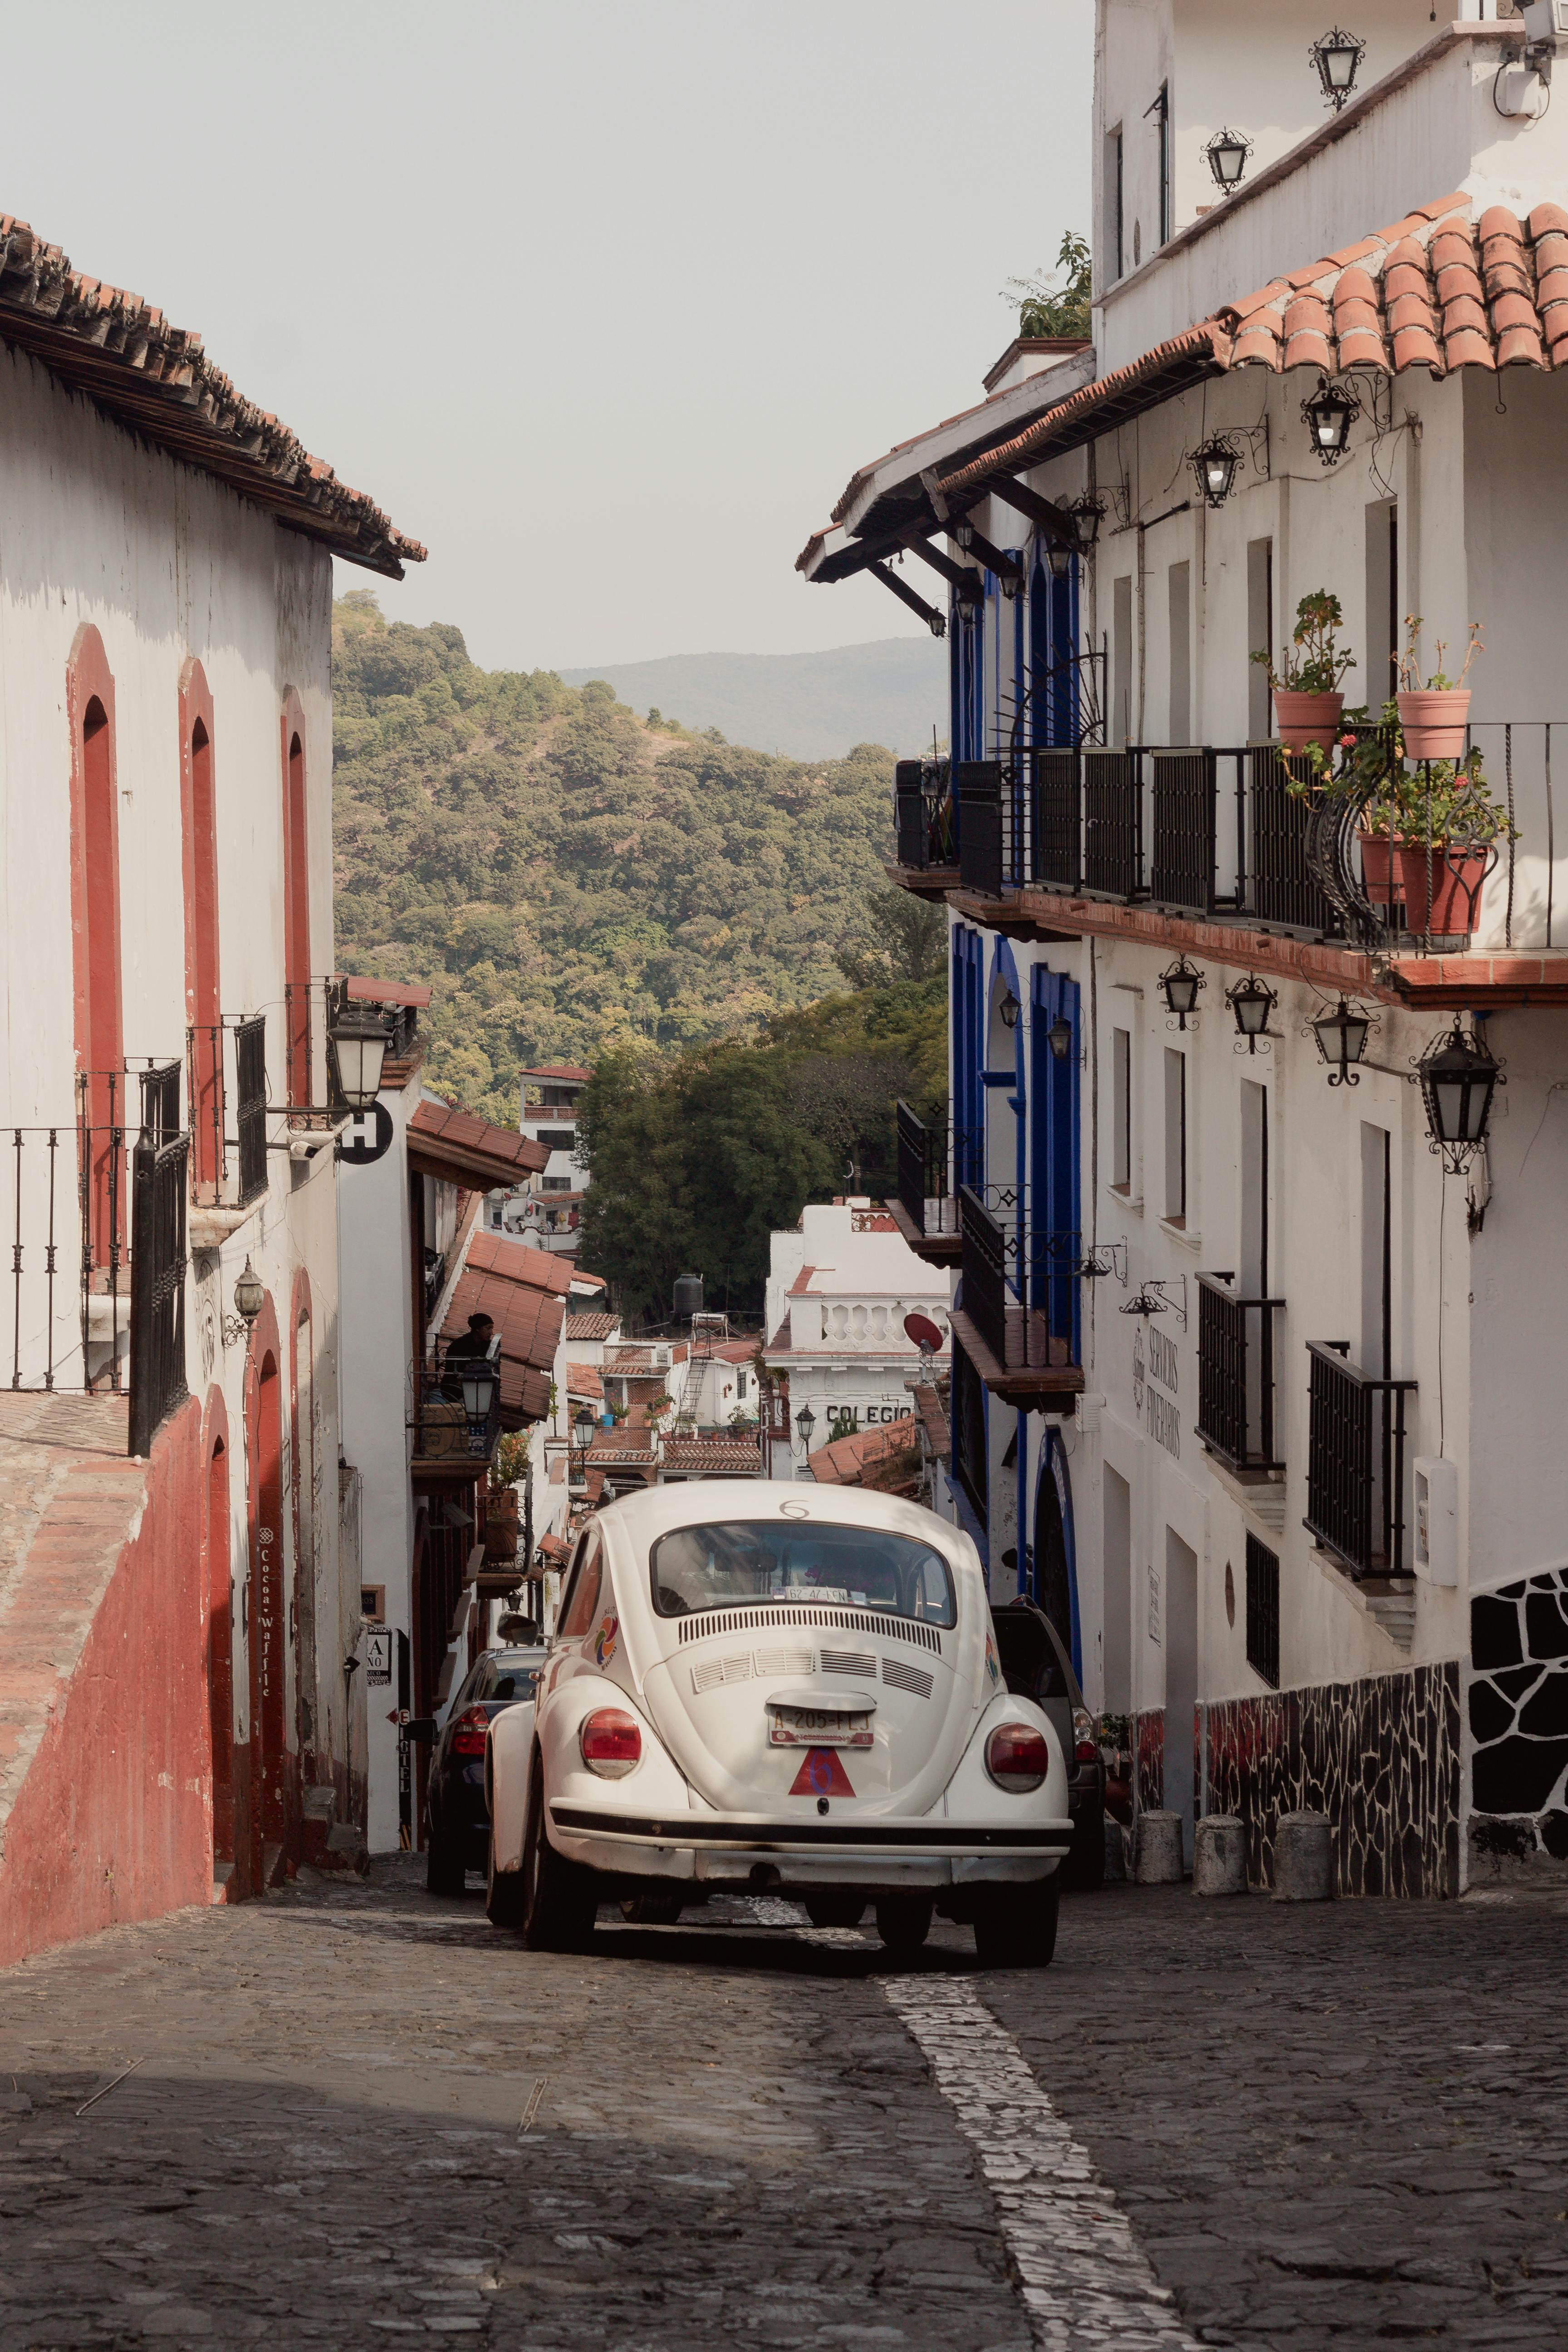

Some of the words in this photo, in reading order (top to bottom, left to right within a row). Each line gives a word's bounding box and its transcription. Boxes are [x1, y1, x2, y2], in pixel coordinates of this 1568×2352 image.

[342, 1112, 377, 1147] H
[1149, 1324, 1178, 1394] SERVICIOS
[827, 1406, 911, 1423] COLEGIO
[1147, 1384, 1180, 1460] FUNERARIOS
[779, 1499, 810, 1519] 6
[261, 1550, 270, 1603] Cocoa
[261, 1617, 273, 1696] Waffle
[809, 1746, 832, 1795] 6
